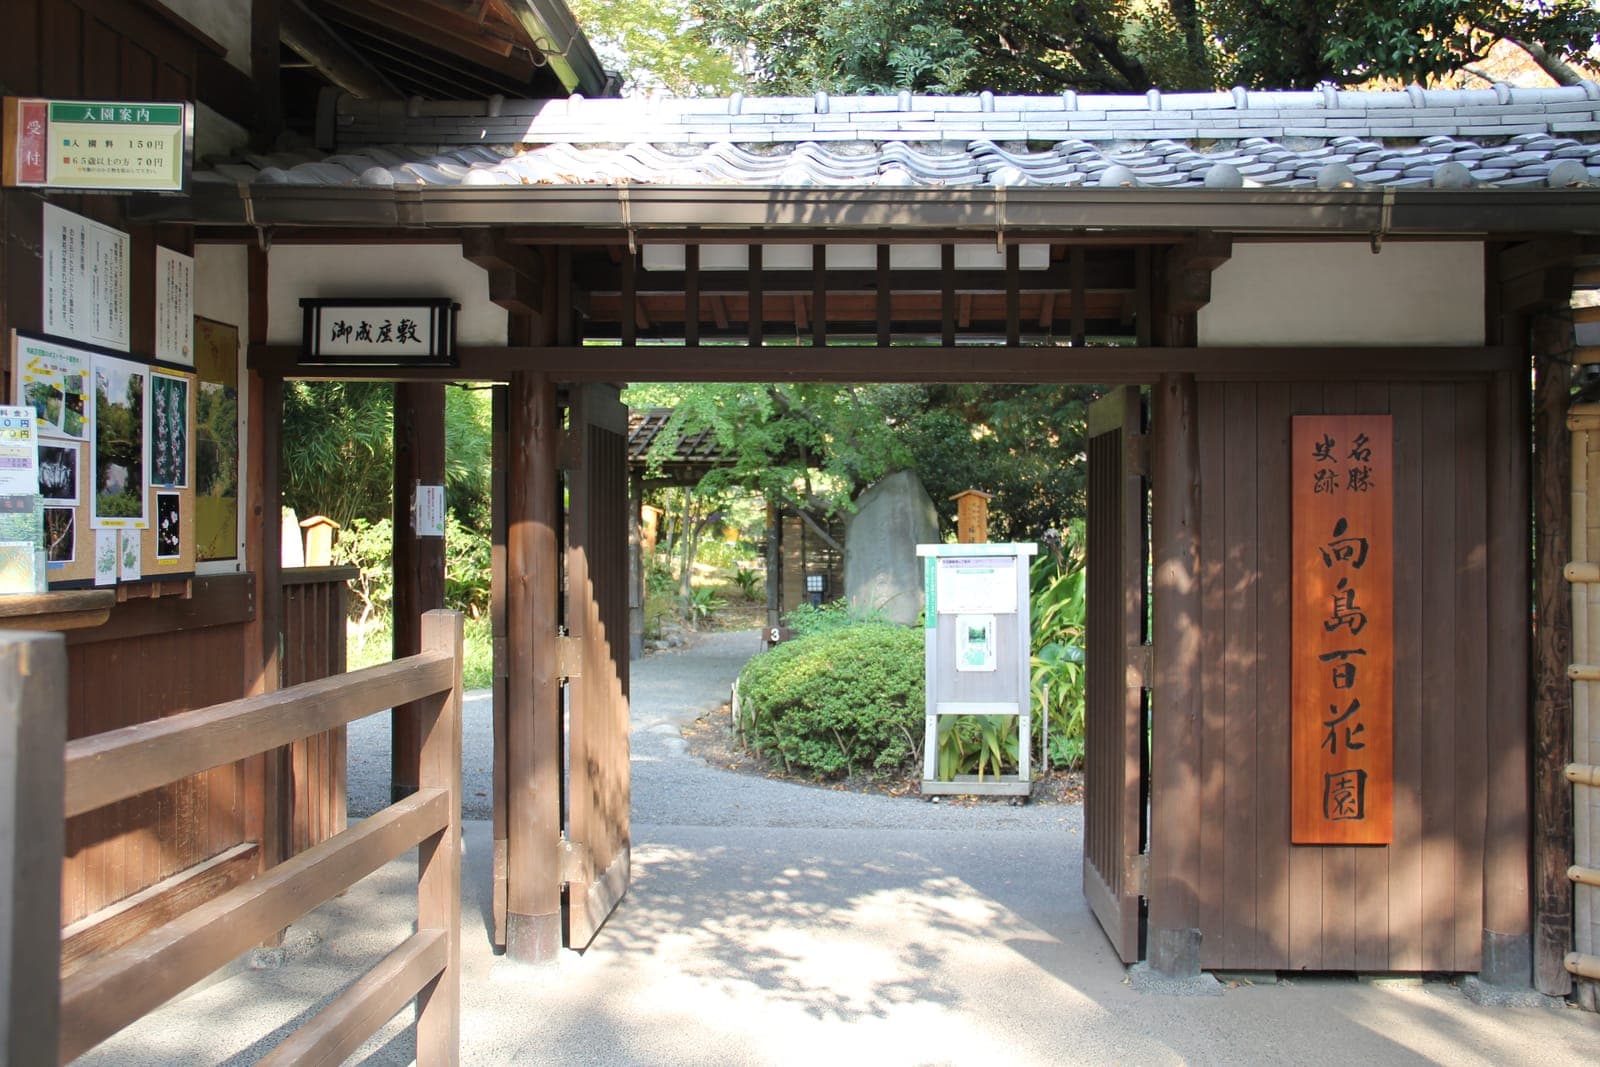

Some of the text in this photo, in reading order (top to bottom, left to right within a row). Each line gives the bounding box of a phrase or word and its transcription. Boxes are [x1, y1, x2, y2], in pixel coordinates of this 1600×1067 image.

[82, 107, 151, 122] 入園案内
[25, 120, 41, 166] 受付
[71, 139, 164, 150] 入園料 150円
[136, 158, 164, 168] 70円
[331, 318, 422, 344] 御成座敷
[1312, 433, 1340, 494] 史跡
[1346, 432, 1376, 492] 名勝
[770, 628, 780, 641] 3
[1318, 517, 1369, 823] 向島百花園
